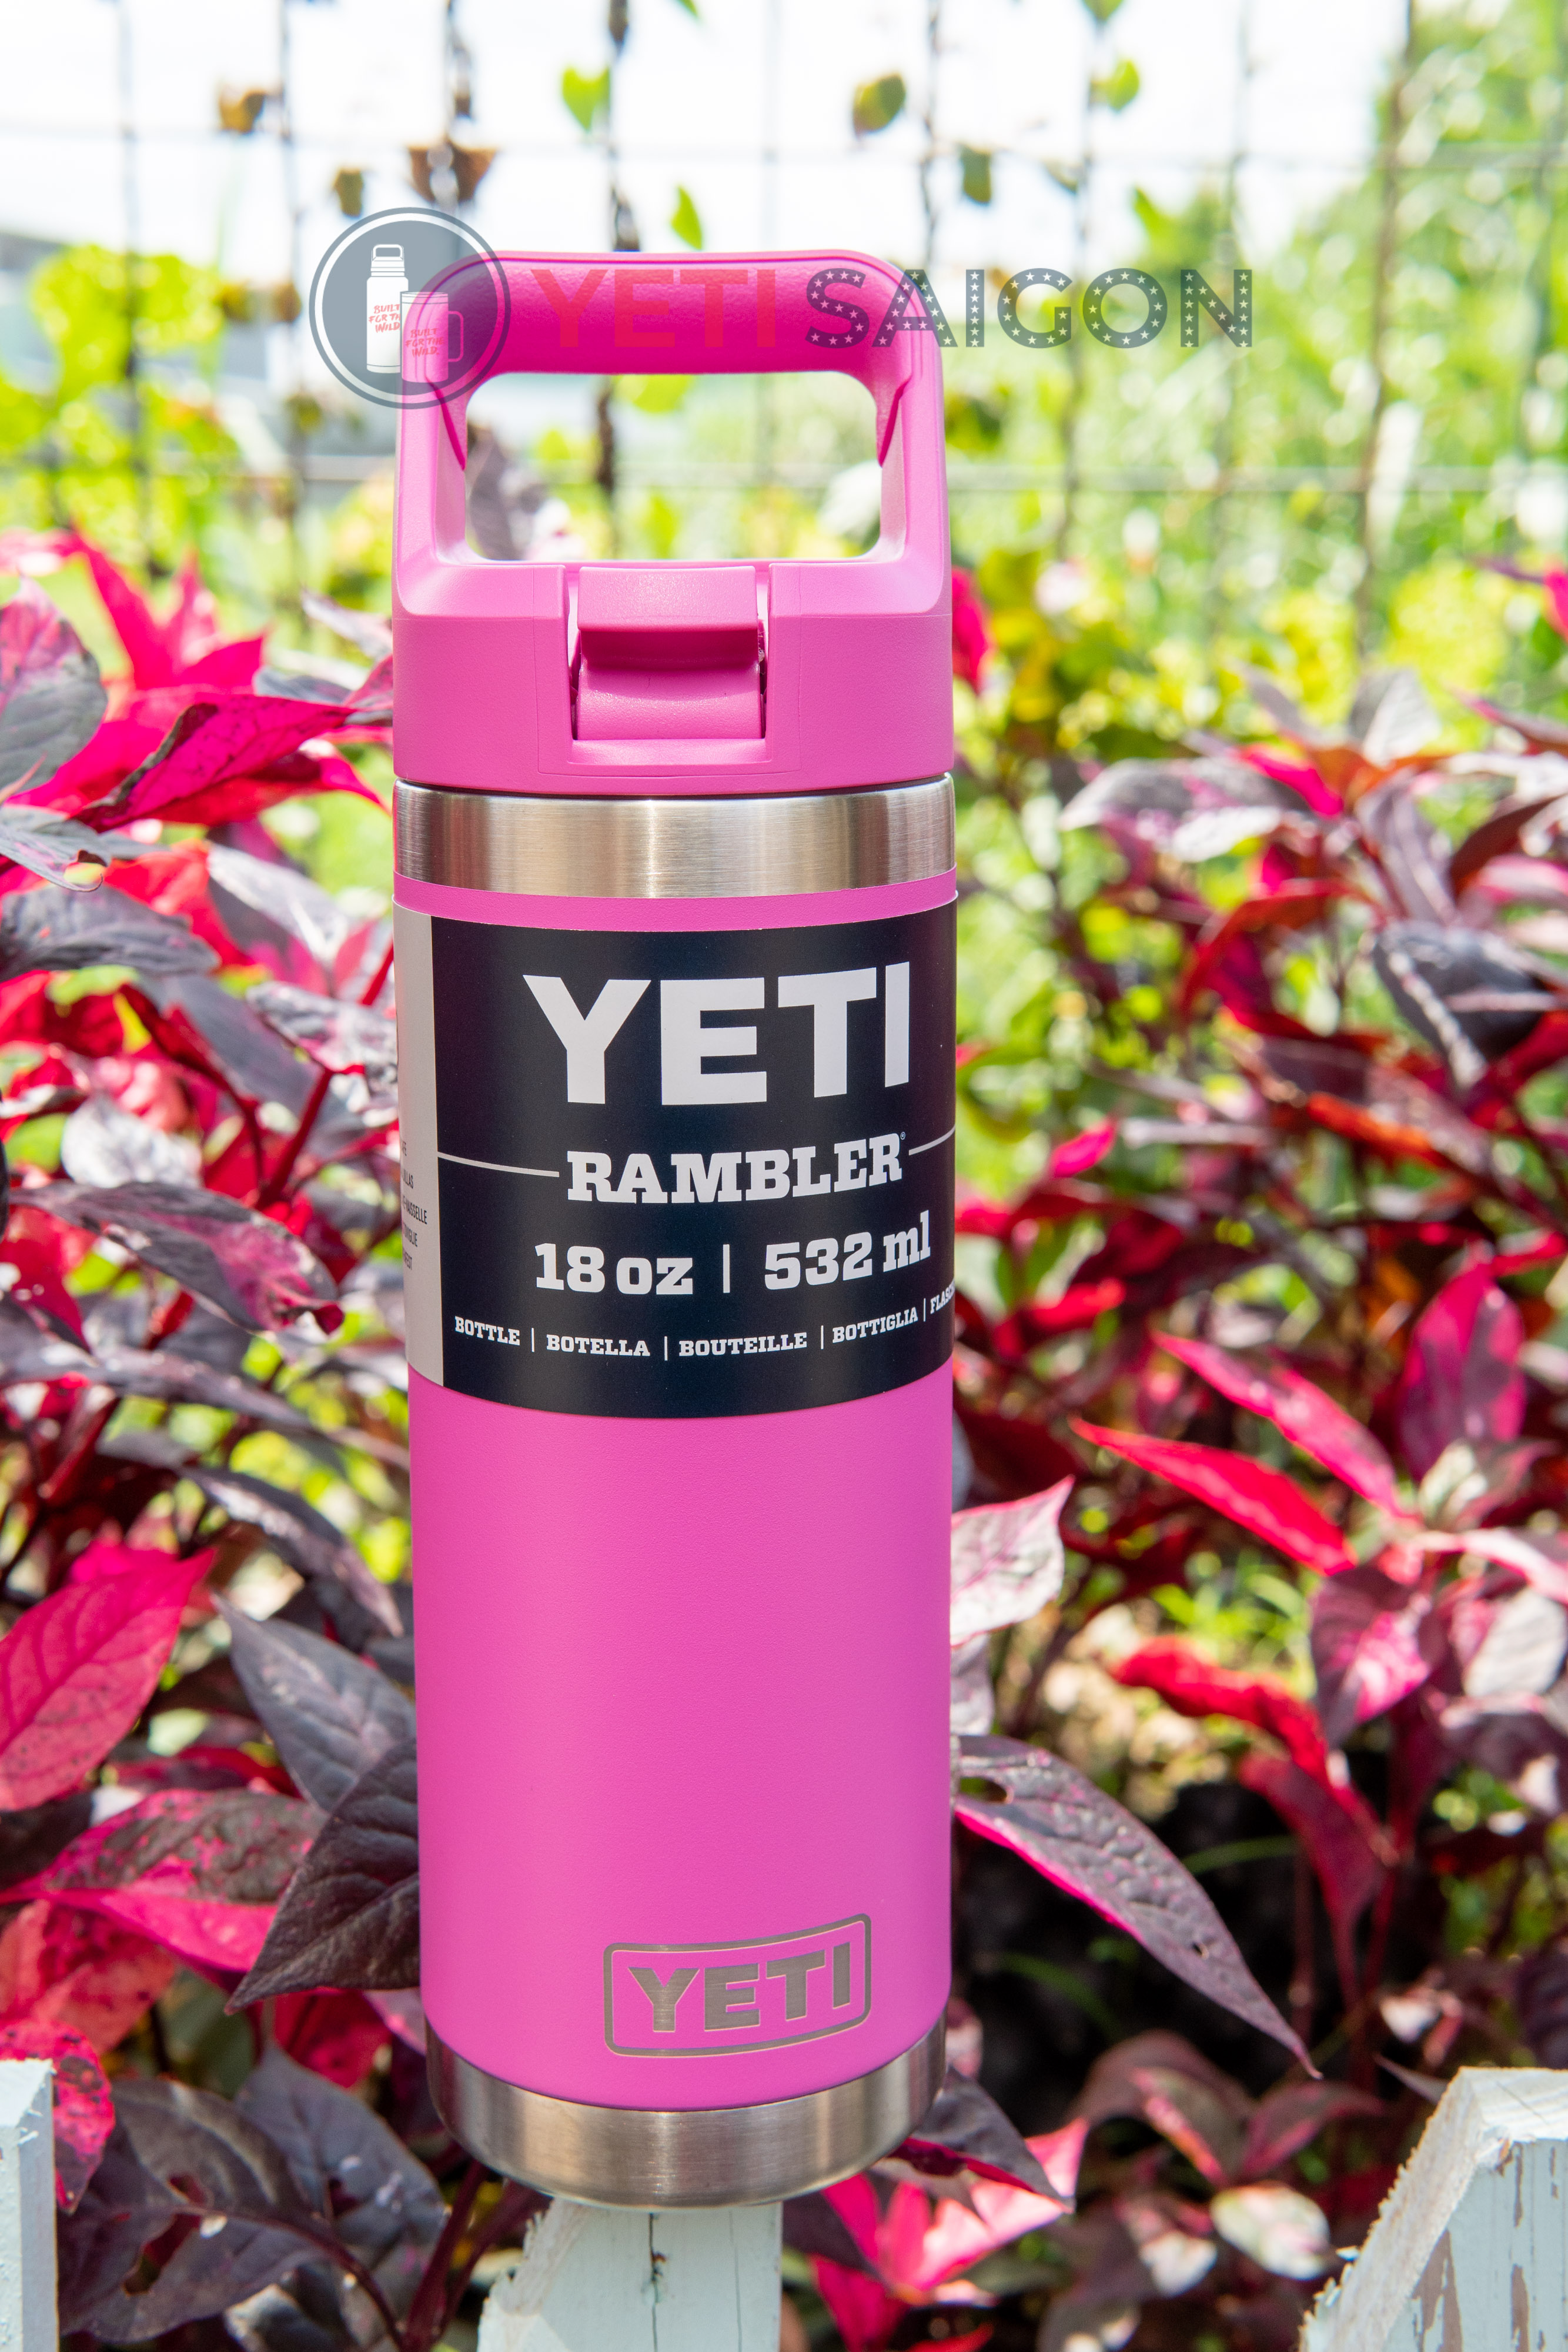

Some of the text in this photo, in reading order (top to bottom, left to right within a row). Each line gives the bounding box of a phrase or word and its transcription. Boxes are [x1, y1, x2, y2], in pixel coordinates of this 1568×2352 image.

[522, 961, 910, 1105] YETI
[534, 1210, 930, 1295] 18 oz 532 ml
[454, 1316, 520, 1346] BOTTLE
[546, 1334, 650, 1357] BOTELLA
[678, 1332, 807, 1357] BOUTEILLE
[833, 1307, 918, 1344] BOTTIGLIA
[628, 1942, 851, 2032] YETI
